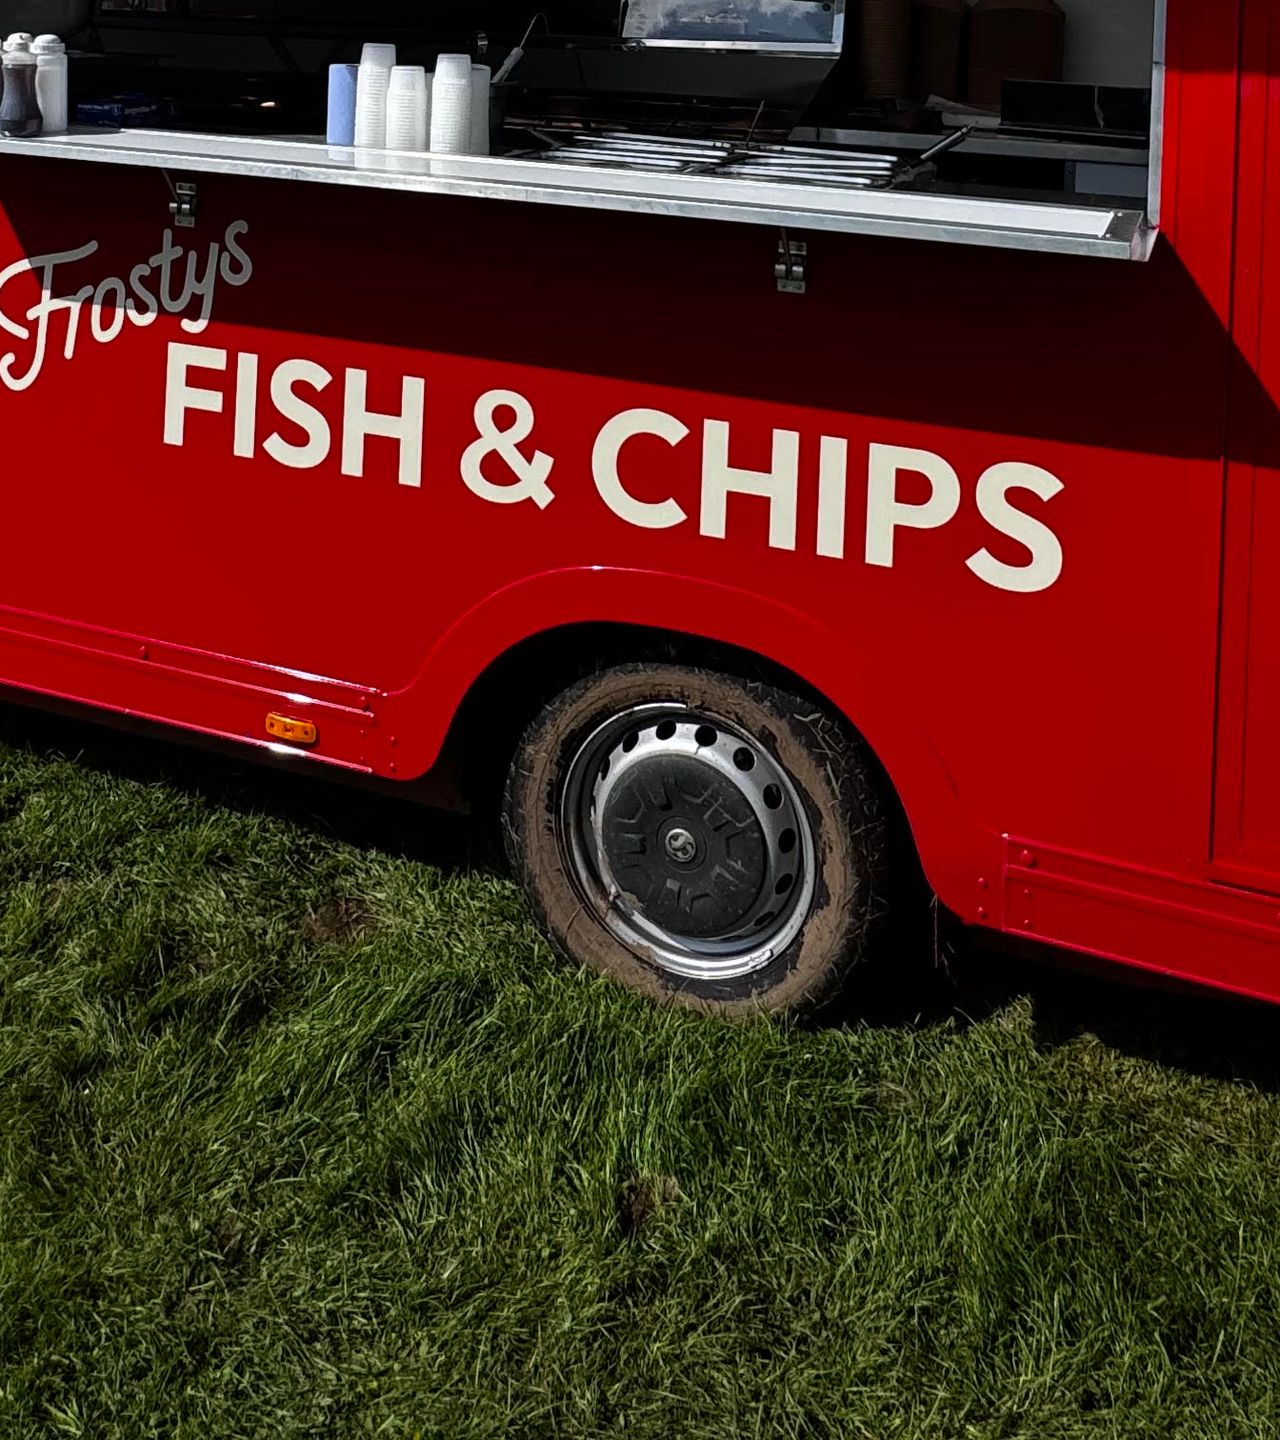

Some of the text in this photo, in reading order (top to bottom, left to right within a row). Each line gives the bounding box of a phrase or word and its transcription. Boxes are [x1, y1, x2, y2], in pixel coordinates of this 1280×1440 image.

[163, 342, 1064, 592] FISH & CHIPS
